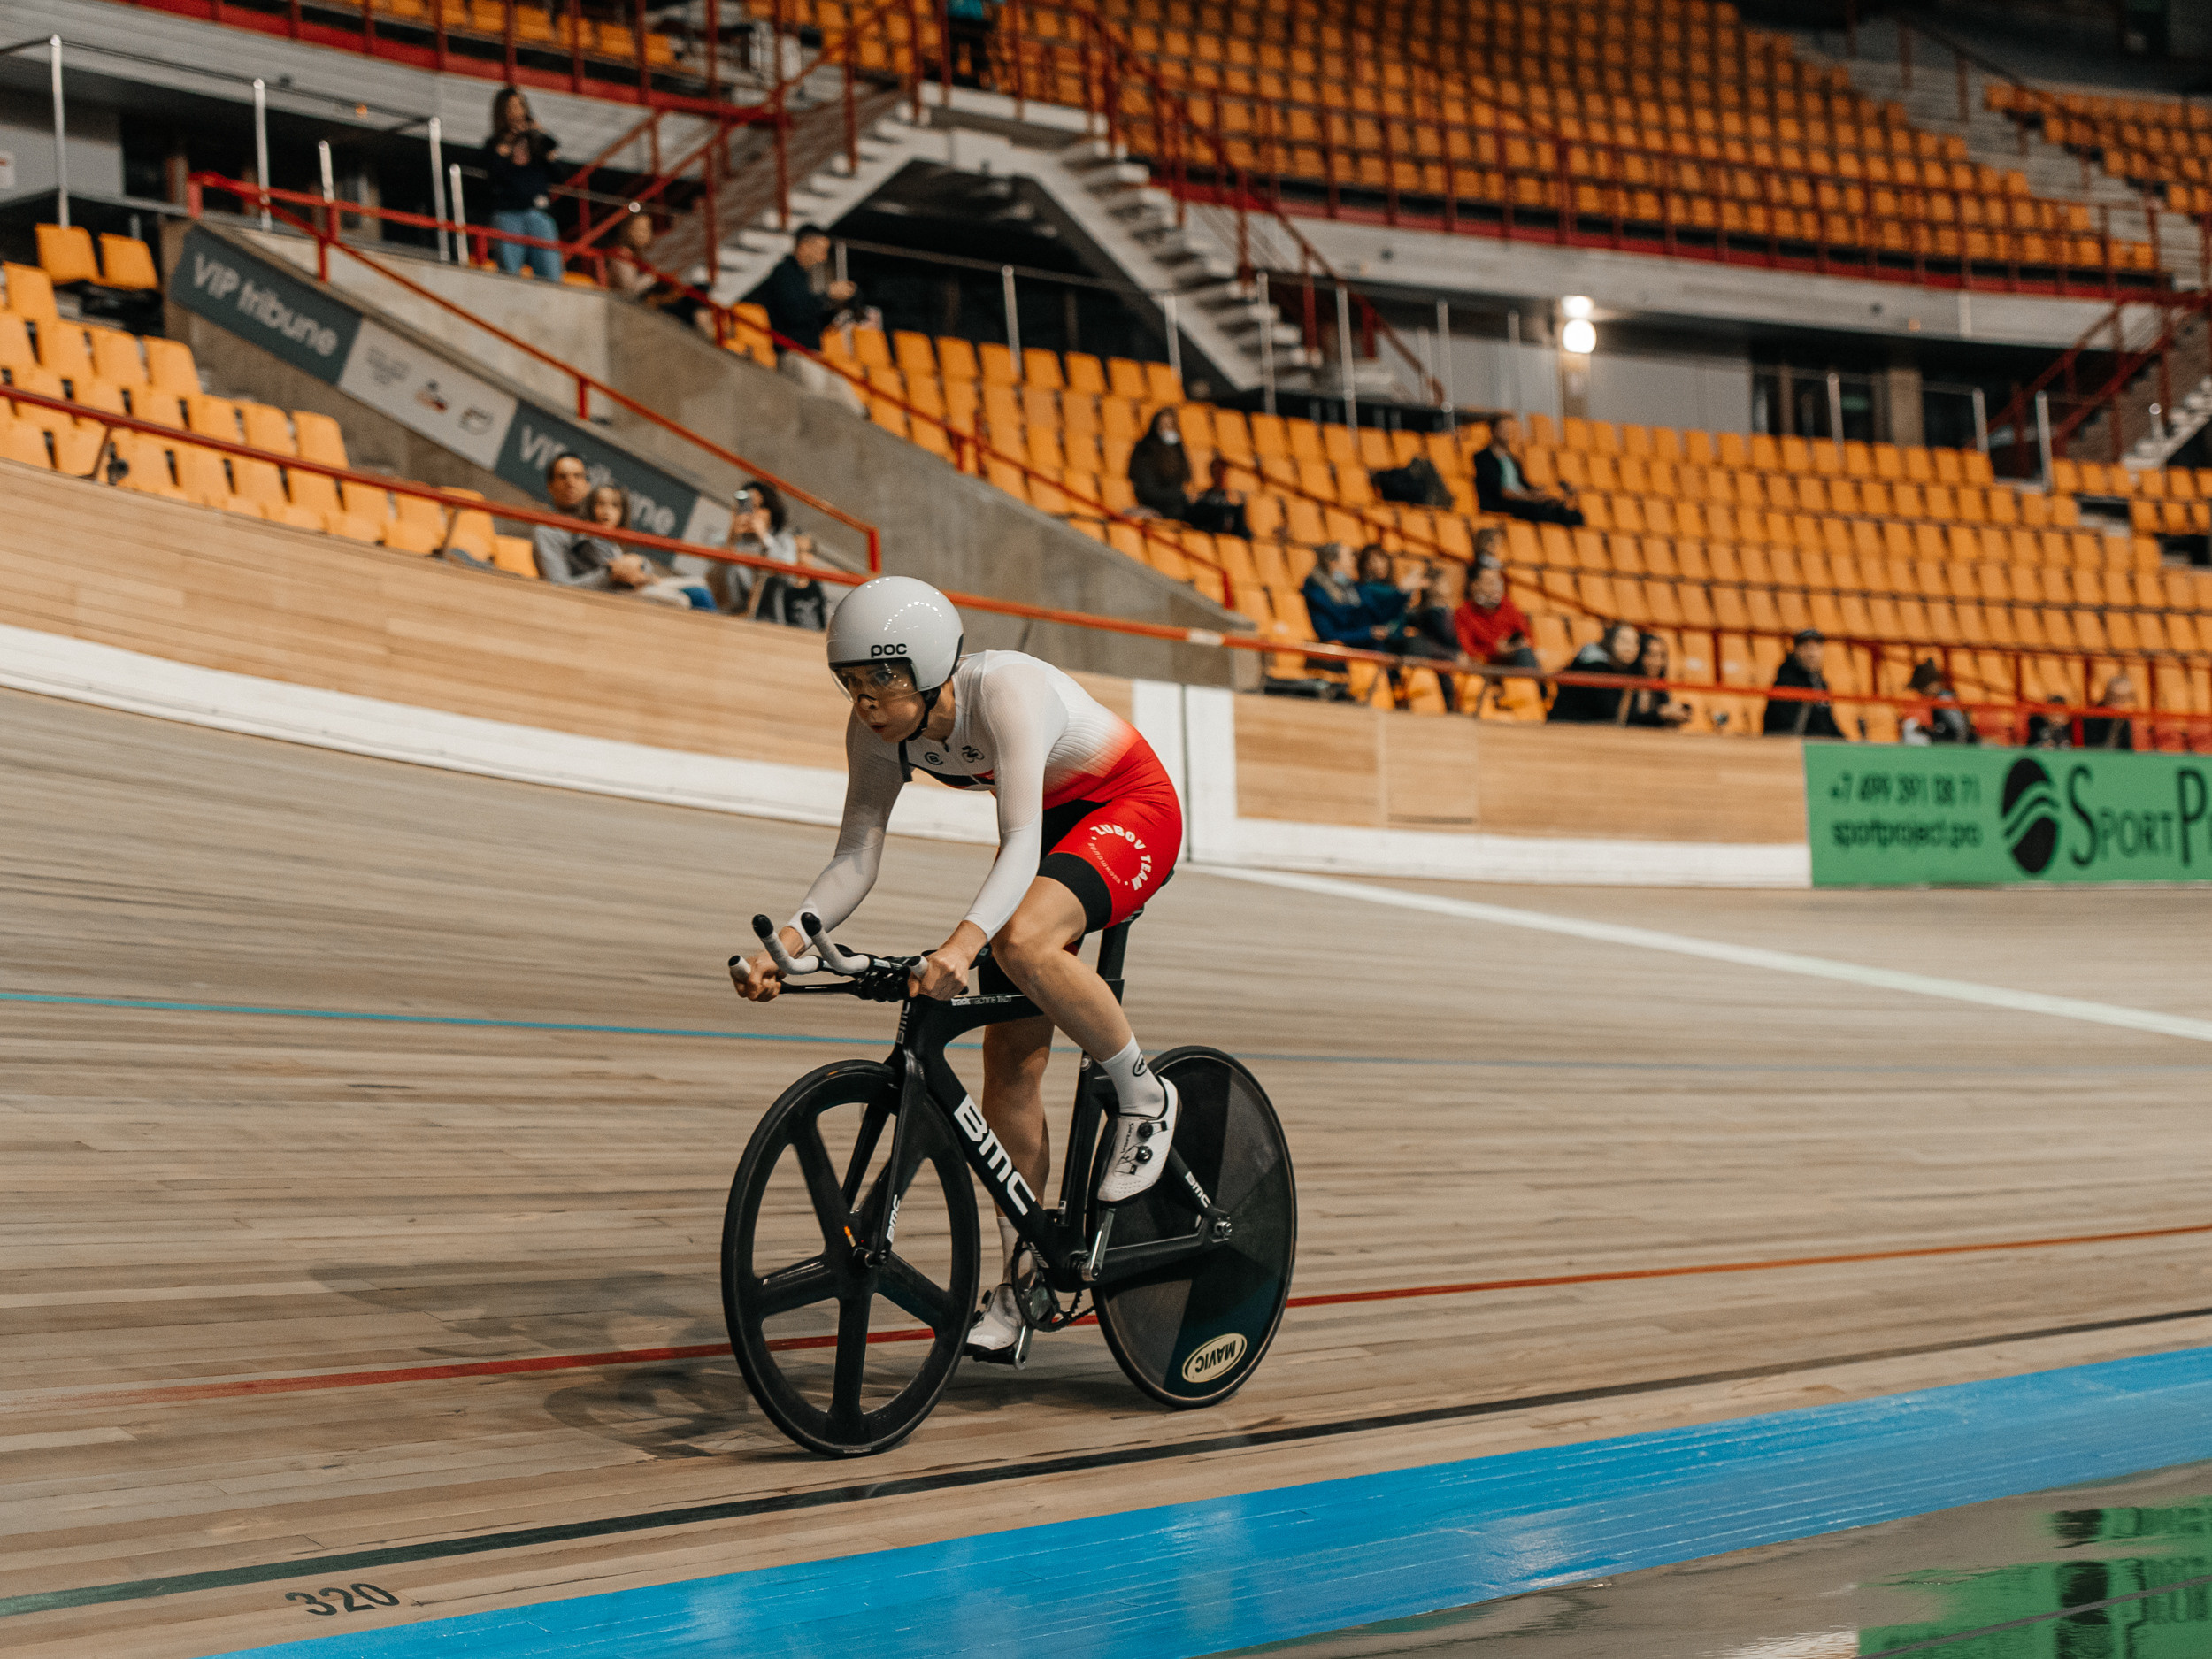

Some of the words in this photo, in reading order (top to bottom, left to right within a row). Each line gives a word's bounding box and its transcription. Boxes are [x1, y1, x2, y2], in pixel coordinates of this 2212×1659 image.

[194, 252, 241, 299] VIP
[237, 279, 339, 357] tribune
[1831, 817, 1982, 850] sportproject.pro
[1132, 854, 1152, 891] TEAM
[954, 1094, 1037, 1216] BMC
[1185, 1171, 1211, 1208] BMC
[887, 1194, 901, 1244] BMC
[1194, 1340, 1236, 1373] MAVIC
[285, 1583, 400, 1616] 320
